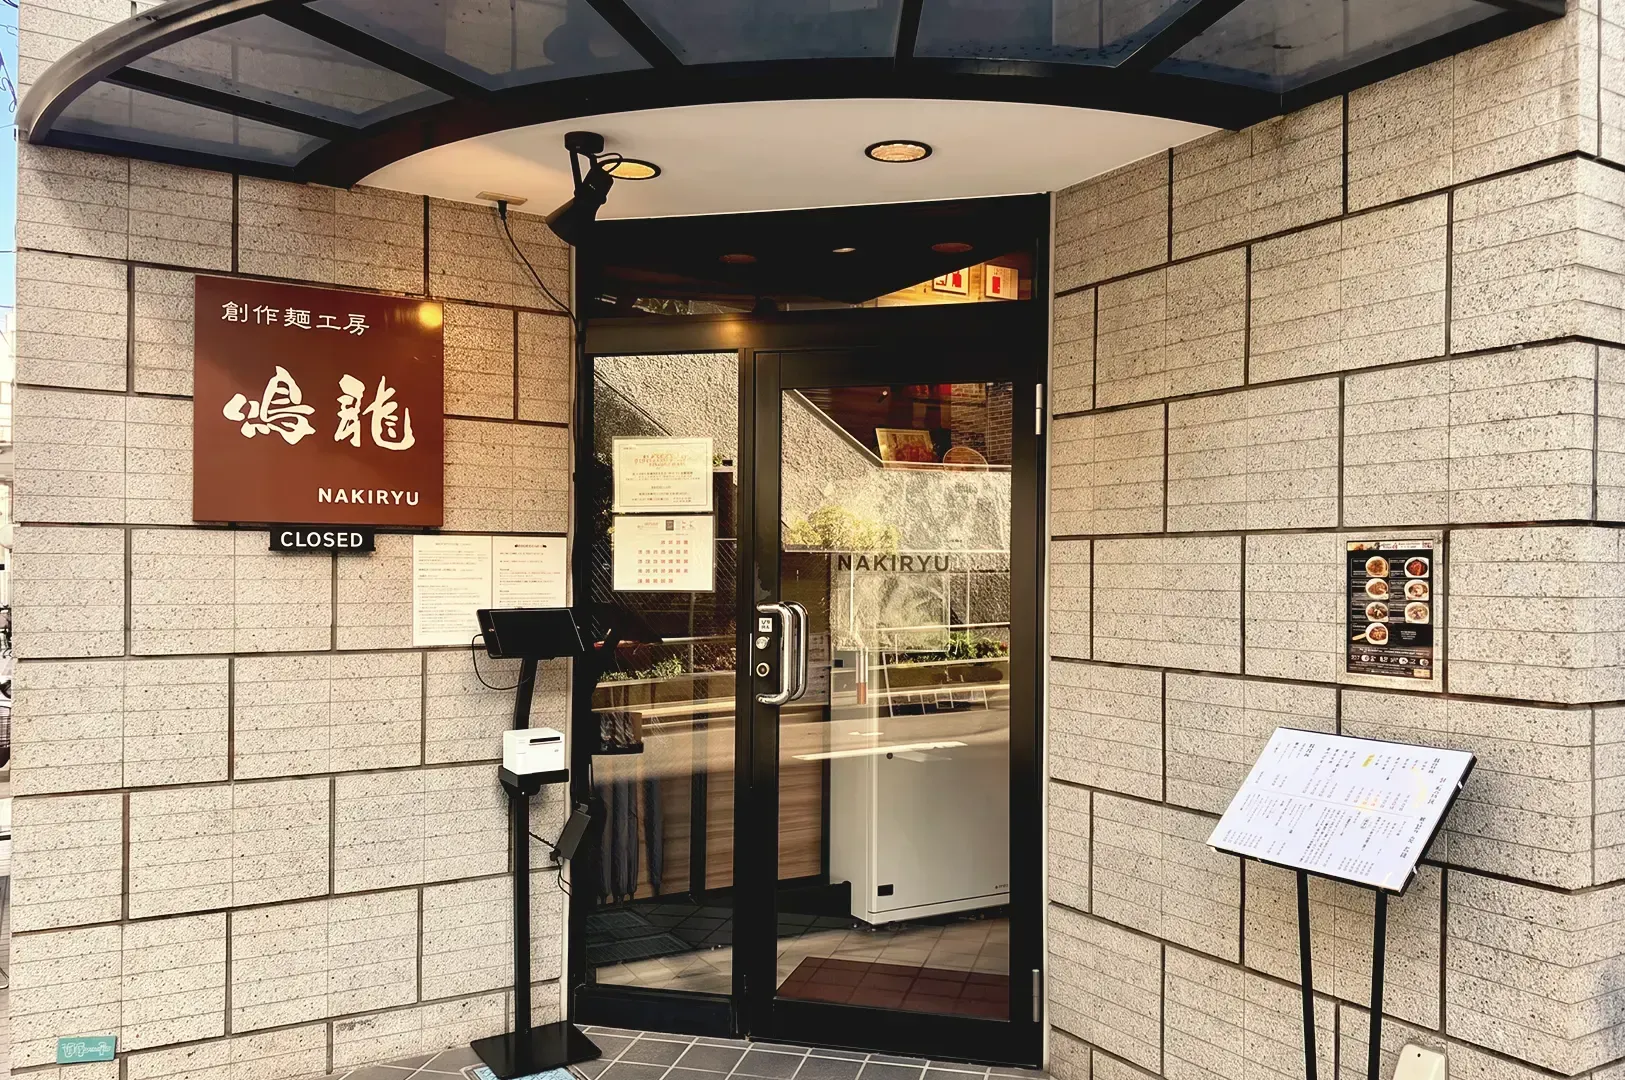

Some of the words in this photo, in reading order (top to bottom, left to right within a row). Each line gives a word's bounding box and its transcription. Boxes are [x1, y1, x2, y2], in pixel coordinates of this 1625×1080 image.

[221, 300, 370, 336] 創作麺工房
[222, 365, 416, 451] 鳴龍
[317, 487, 420, 506] NAKIRYU
[280, 530, 364, 548] CLOSED
[837, 554, 950, 572] NAKIRYU
